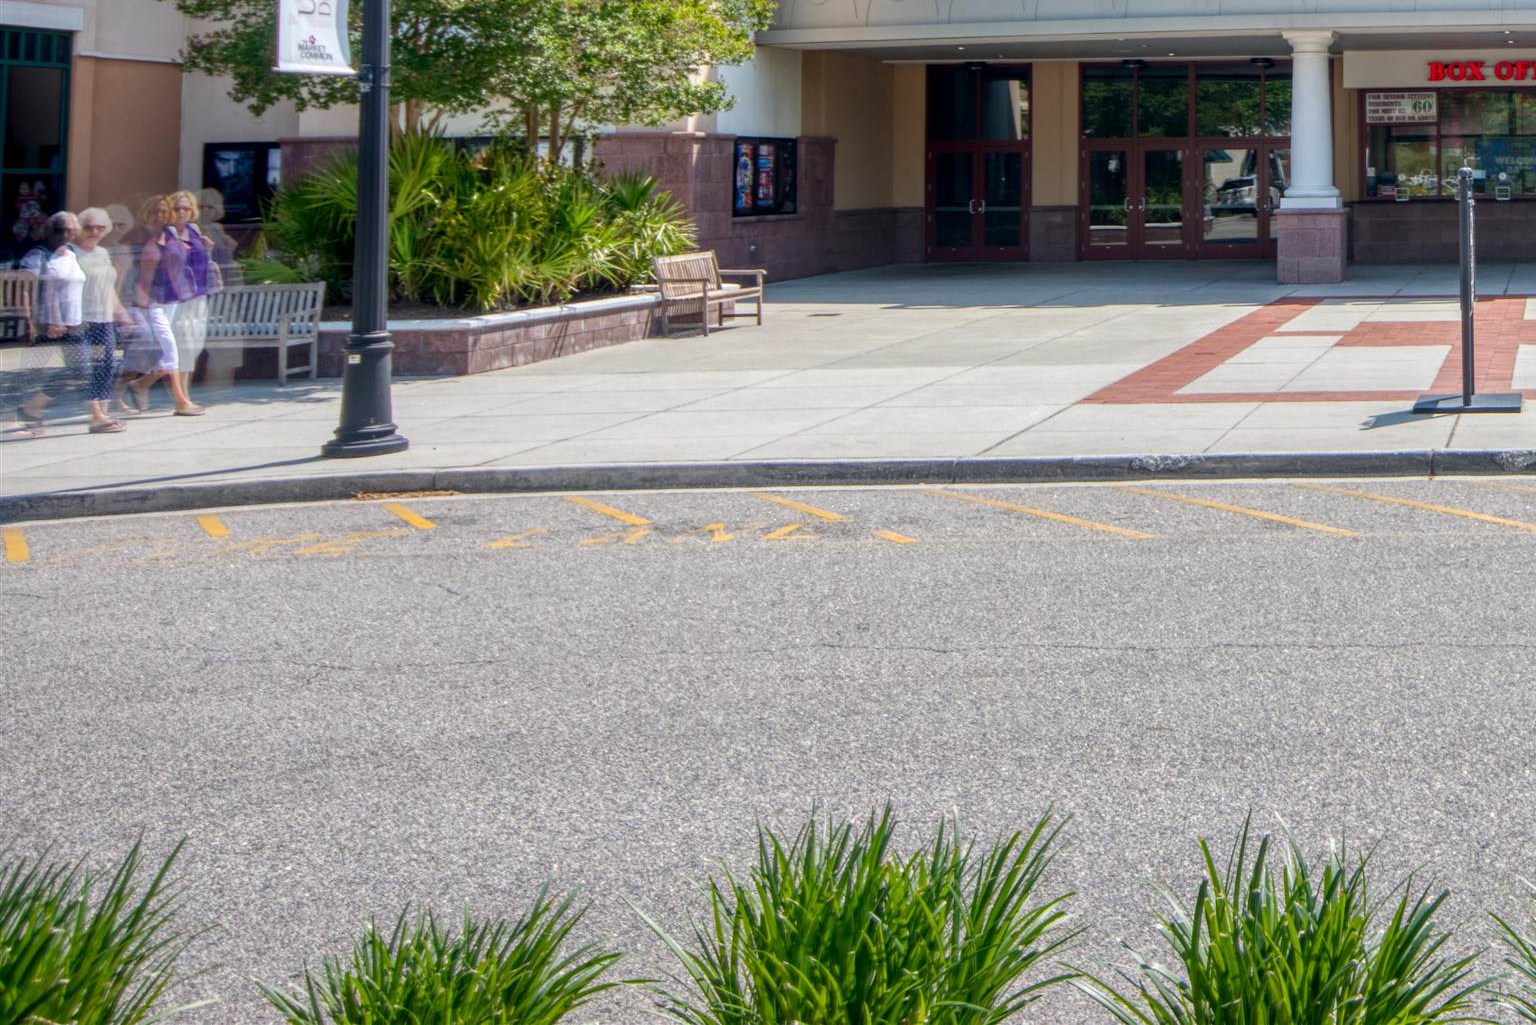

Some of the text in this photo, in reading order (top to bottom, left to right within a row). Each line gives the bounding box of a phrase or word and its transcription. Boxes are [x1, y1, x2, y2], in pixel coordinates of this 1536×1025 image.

[298, 43, 326, 52] MARKET
[300, 51, 332, 61] COMMON
[1428, 61, 1486, 81] BOX
[1413, 101, 1433, 113] 60
